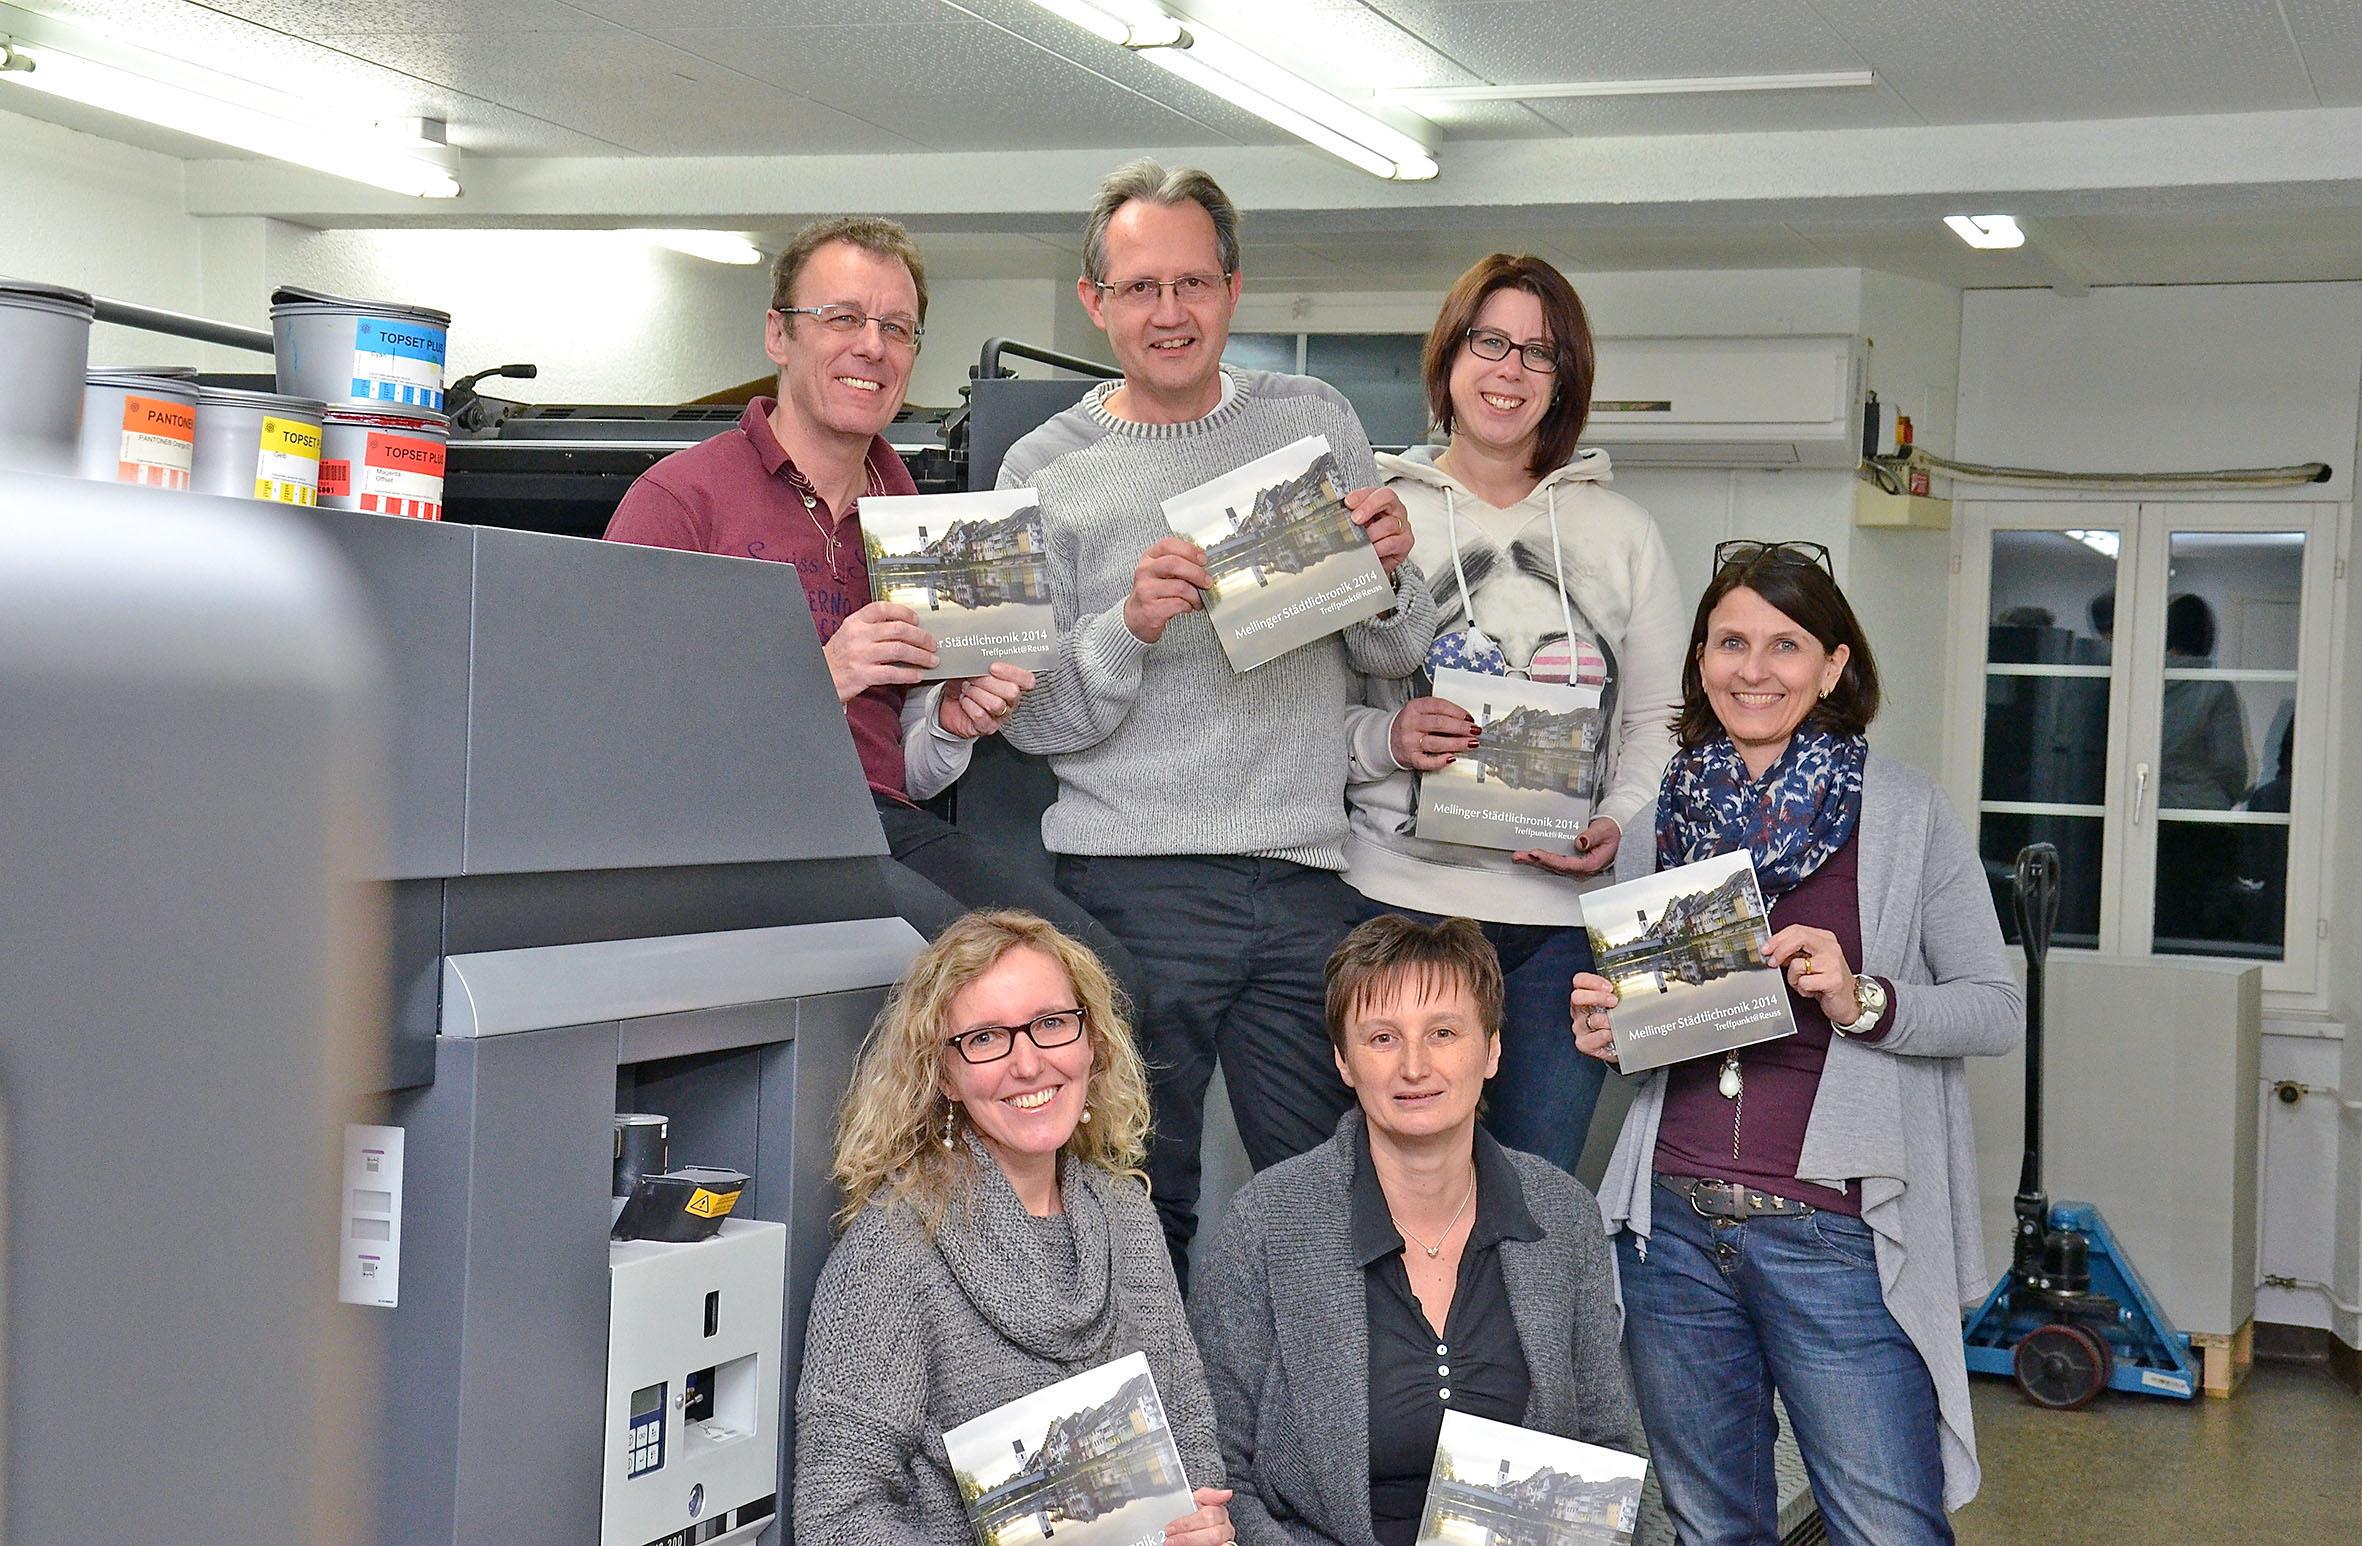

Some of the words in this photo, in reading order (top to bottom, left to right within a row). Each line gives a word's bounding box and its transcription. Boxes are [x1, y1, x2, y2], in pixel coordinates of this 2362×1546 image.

[379, 331, 425, 349] TOPSET
[426, 340, 444, 354] PLUS
[283, 431, 317, 449] TOPSET
[385, 446, 428, 463] TOPSET
[429, 452, 444, 465] PLUS
[1234, 613, 1282, 640] Mellinger
[1283, 582, 1352, 619] Städtlichronik
[1352, 570, 1378, 588] 2014
[1319, 585, 1383, 616] Treffpunkt@Reuss
[945, 631, 1020, 648] Städtlichronik
[1022, 629, 1048, 642] 2014
[981, 644, 1050, 658] Treffpunkt@Reuss
[1433, 802, 1481, 820] Mellinger
[1481, 809, 1553, 828] Städtlichronik
[1555, 818, 1580, 830] 2014
[1514, 827, 1578, 840] Treffpunkt@Reus
[1628, 1021, 1677, 1041] Mellinger
[1678, 1002, 1750, 1029] Städtlichronik
[1751, 994, 1778, 1010] 2014
[1714, 1009, 1782, 1032] Treffpunkt@Reuss
